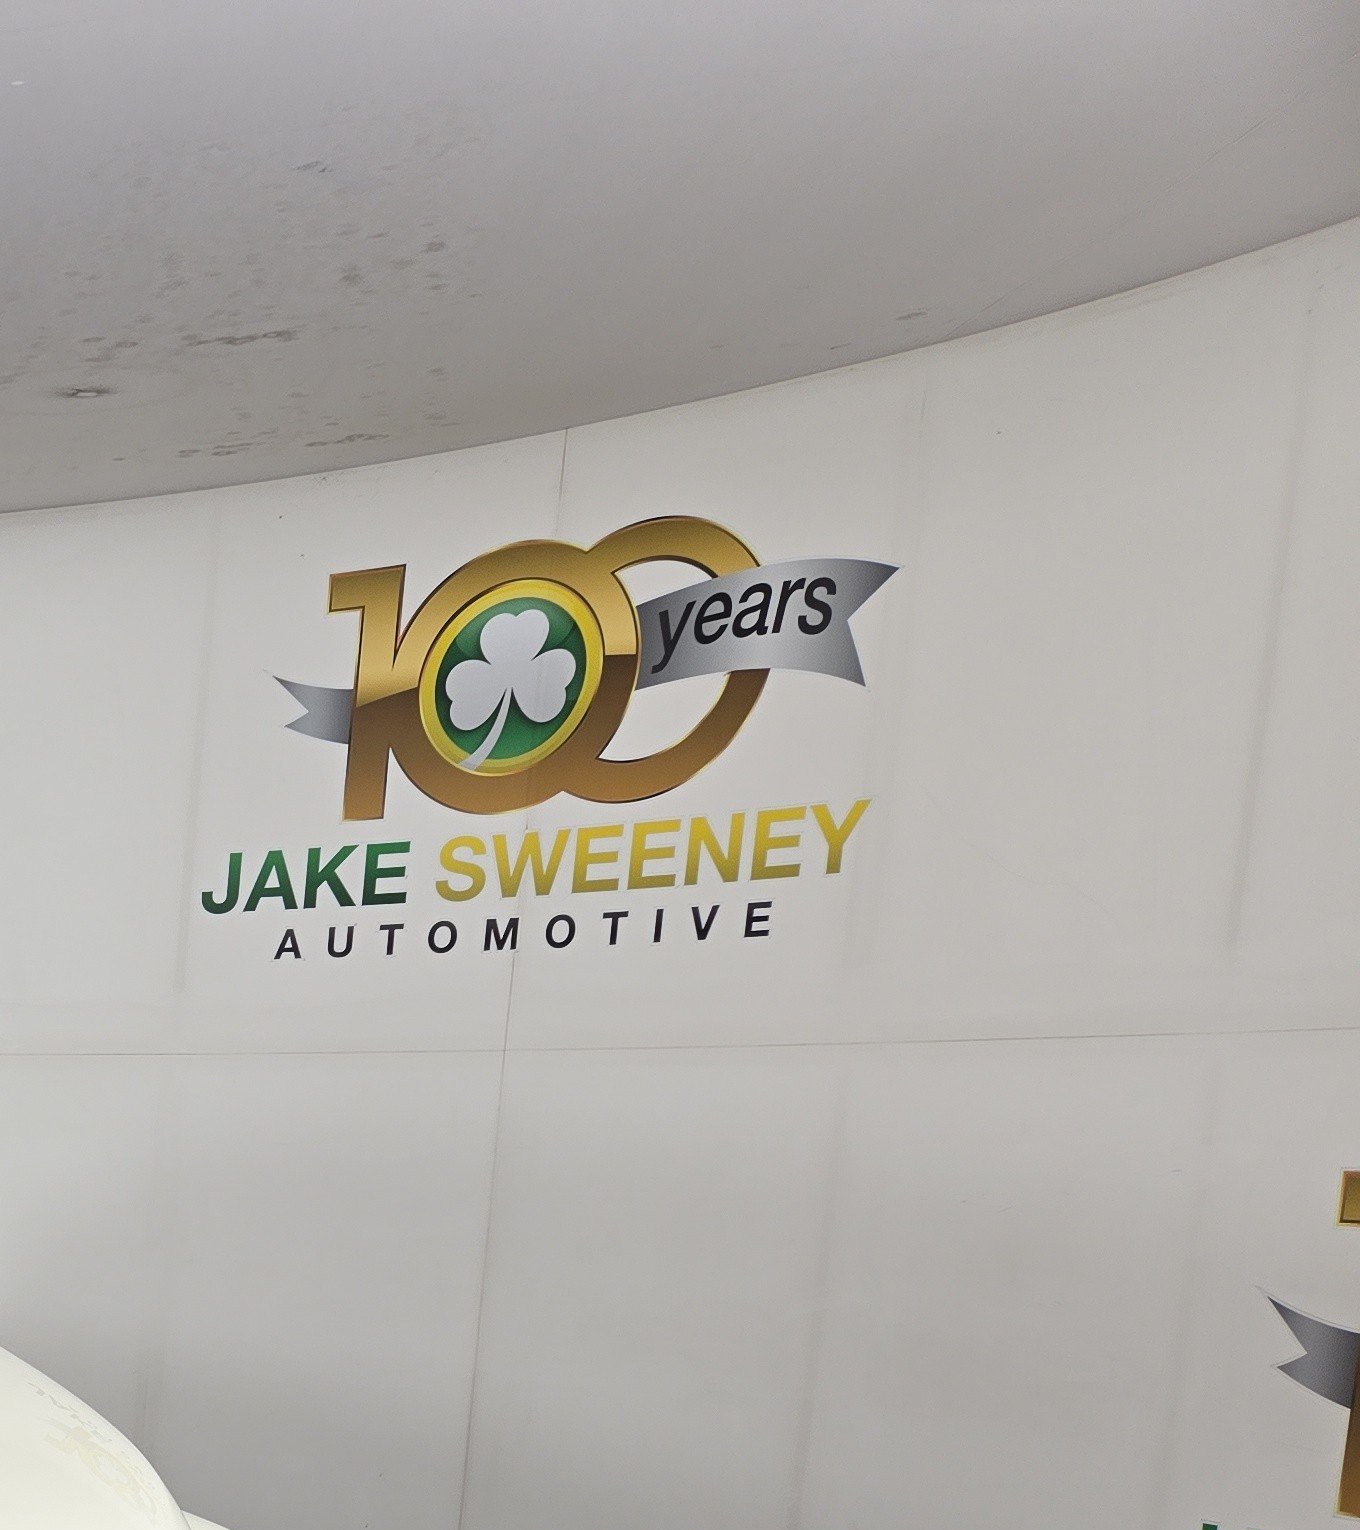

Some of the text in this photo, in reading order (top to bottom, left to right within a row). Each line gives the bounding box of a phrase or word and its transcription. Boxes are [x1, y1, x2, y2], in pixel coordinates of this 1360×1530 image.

[651, 573, 837, 674] years
[201, 799, 872, 915] JAKE SWEENEY
[273, 901, 773, 961] AUTOMOTIVE
